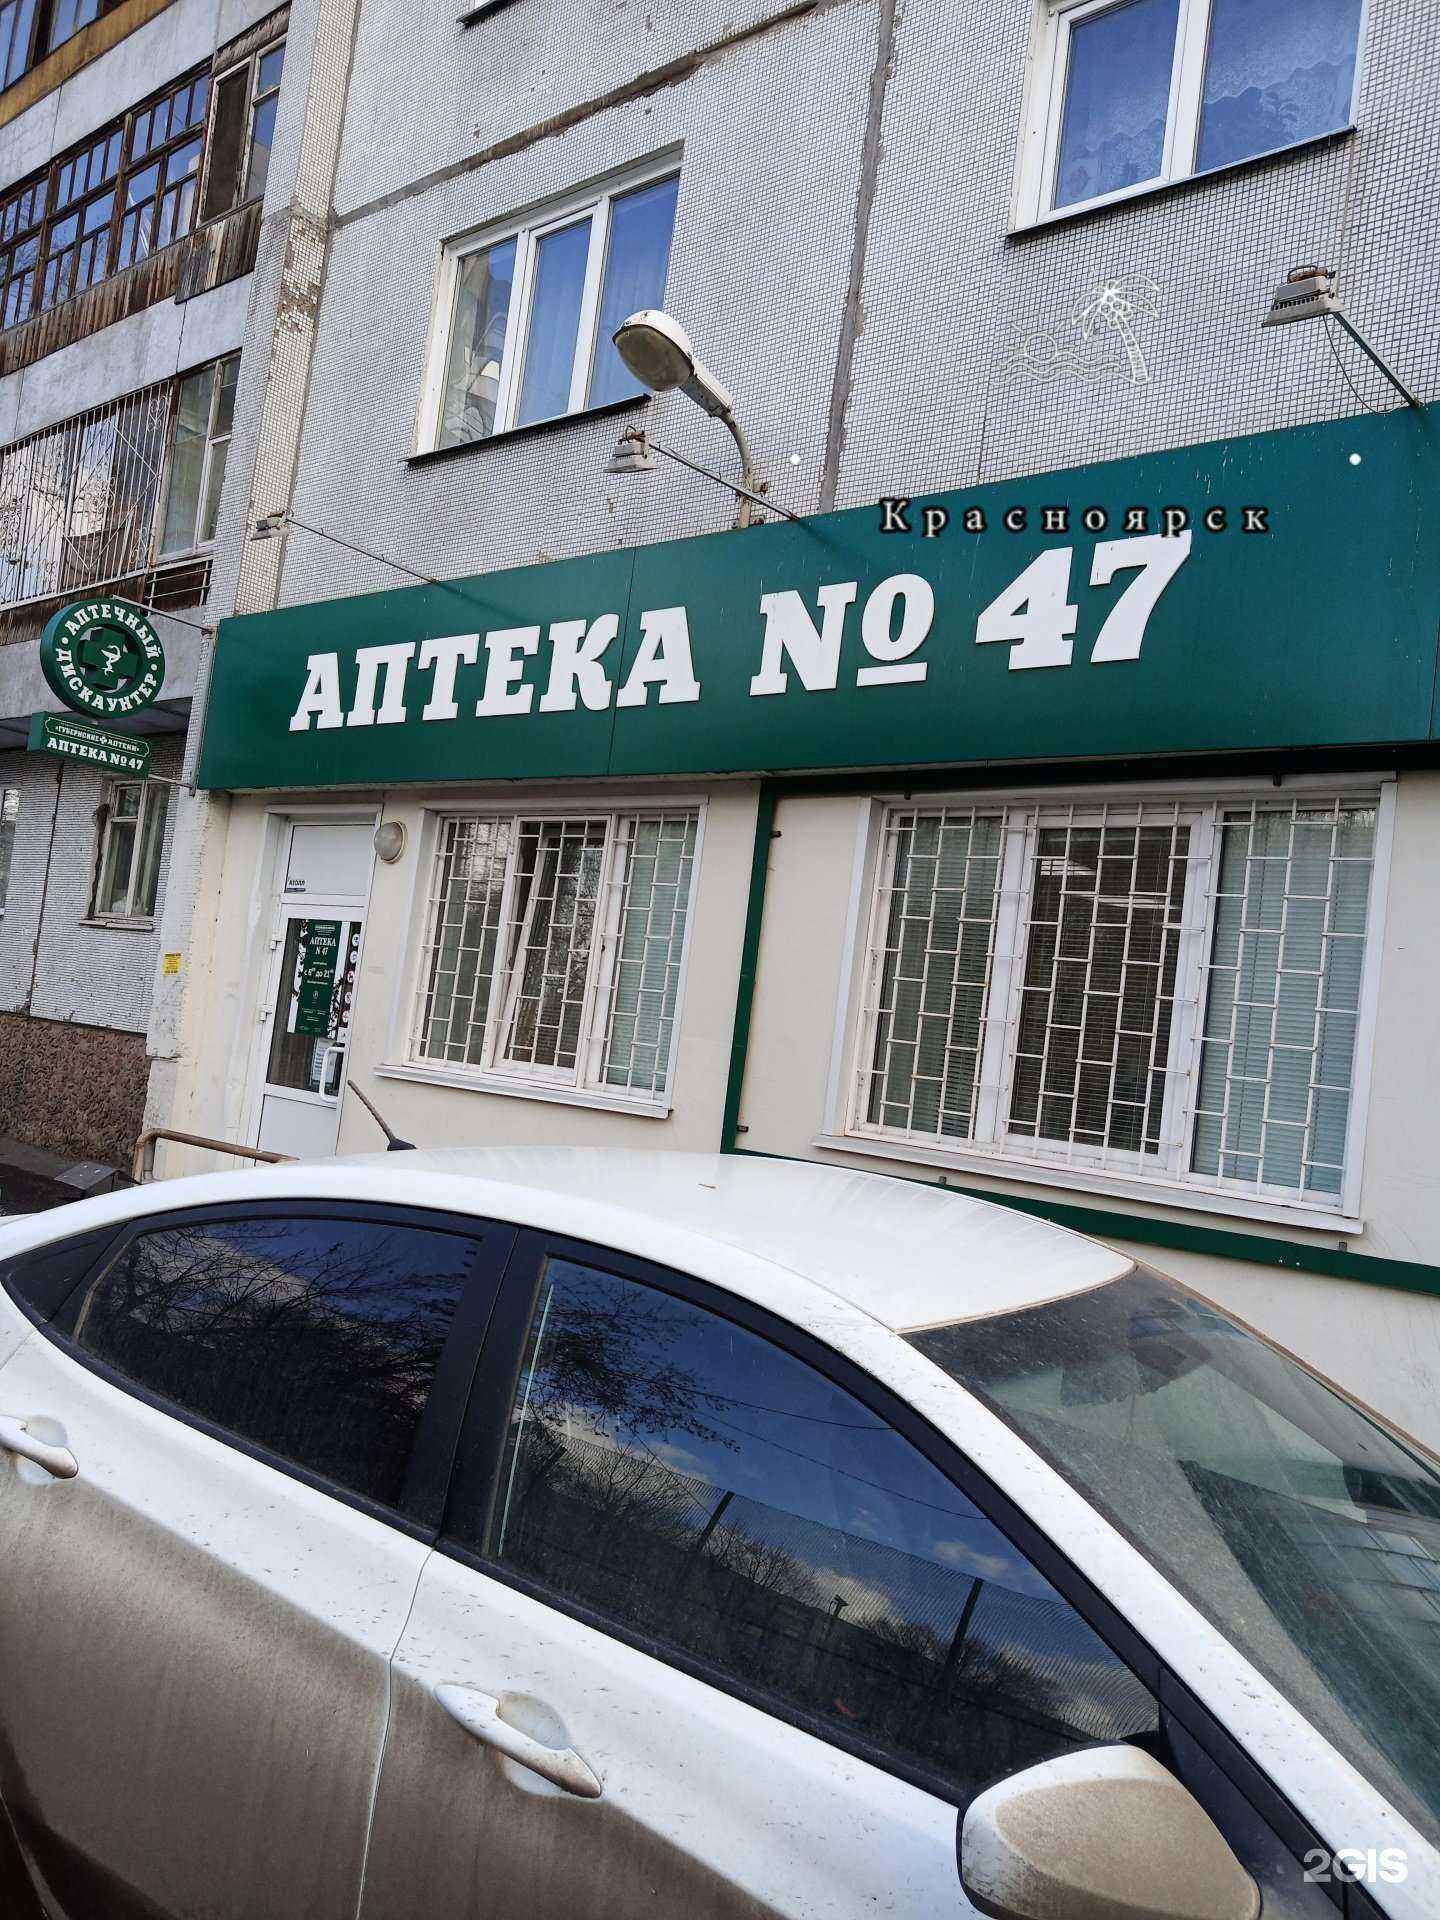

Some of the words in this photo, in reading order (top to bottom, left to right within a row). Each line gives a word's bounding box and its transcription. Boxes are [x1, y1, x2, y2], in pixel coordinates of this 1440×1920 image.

[64, 604, 162, 659] АПТЕЧНЫЙ
[289, 606, 701, 731] АПТЕКА
[749, 573, 935, 696] №
[975, 530, 1192, 670] 47
[55, 648, 157, 712] ДИСКАУНТЕР
[46, 737, 108, 762] АПТЕКА
[128, 757, 144, 770] 47
